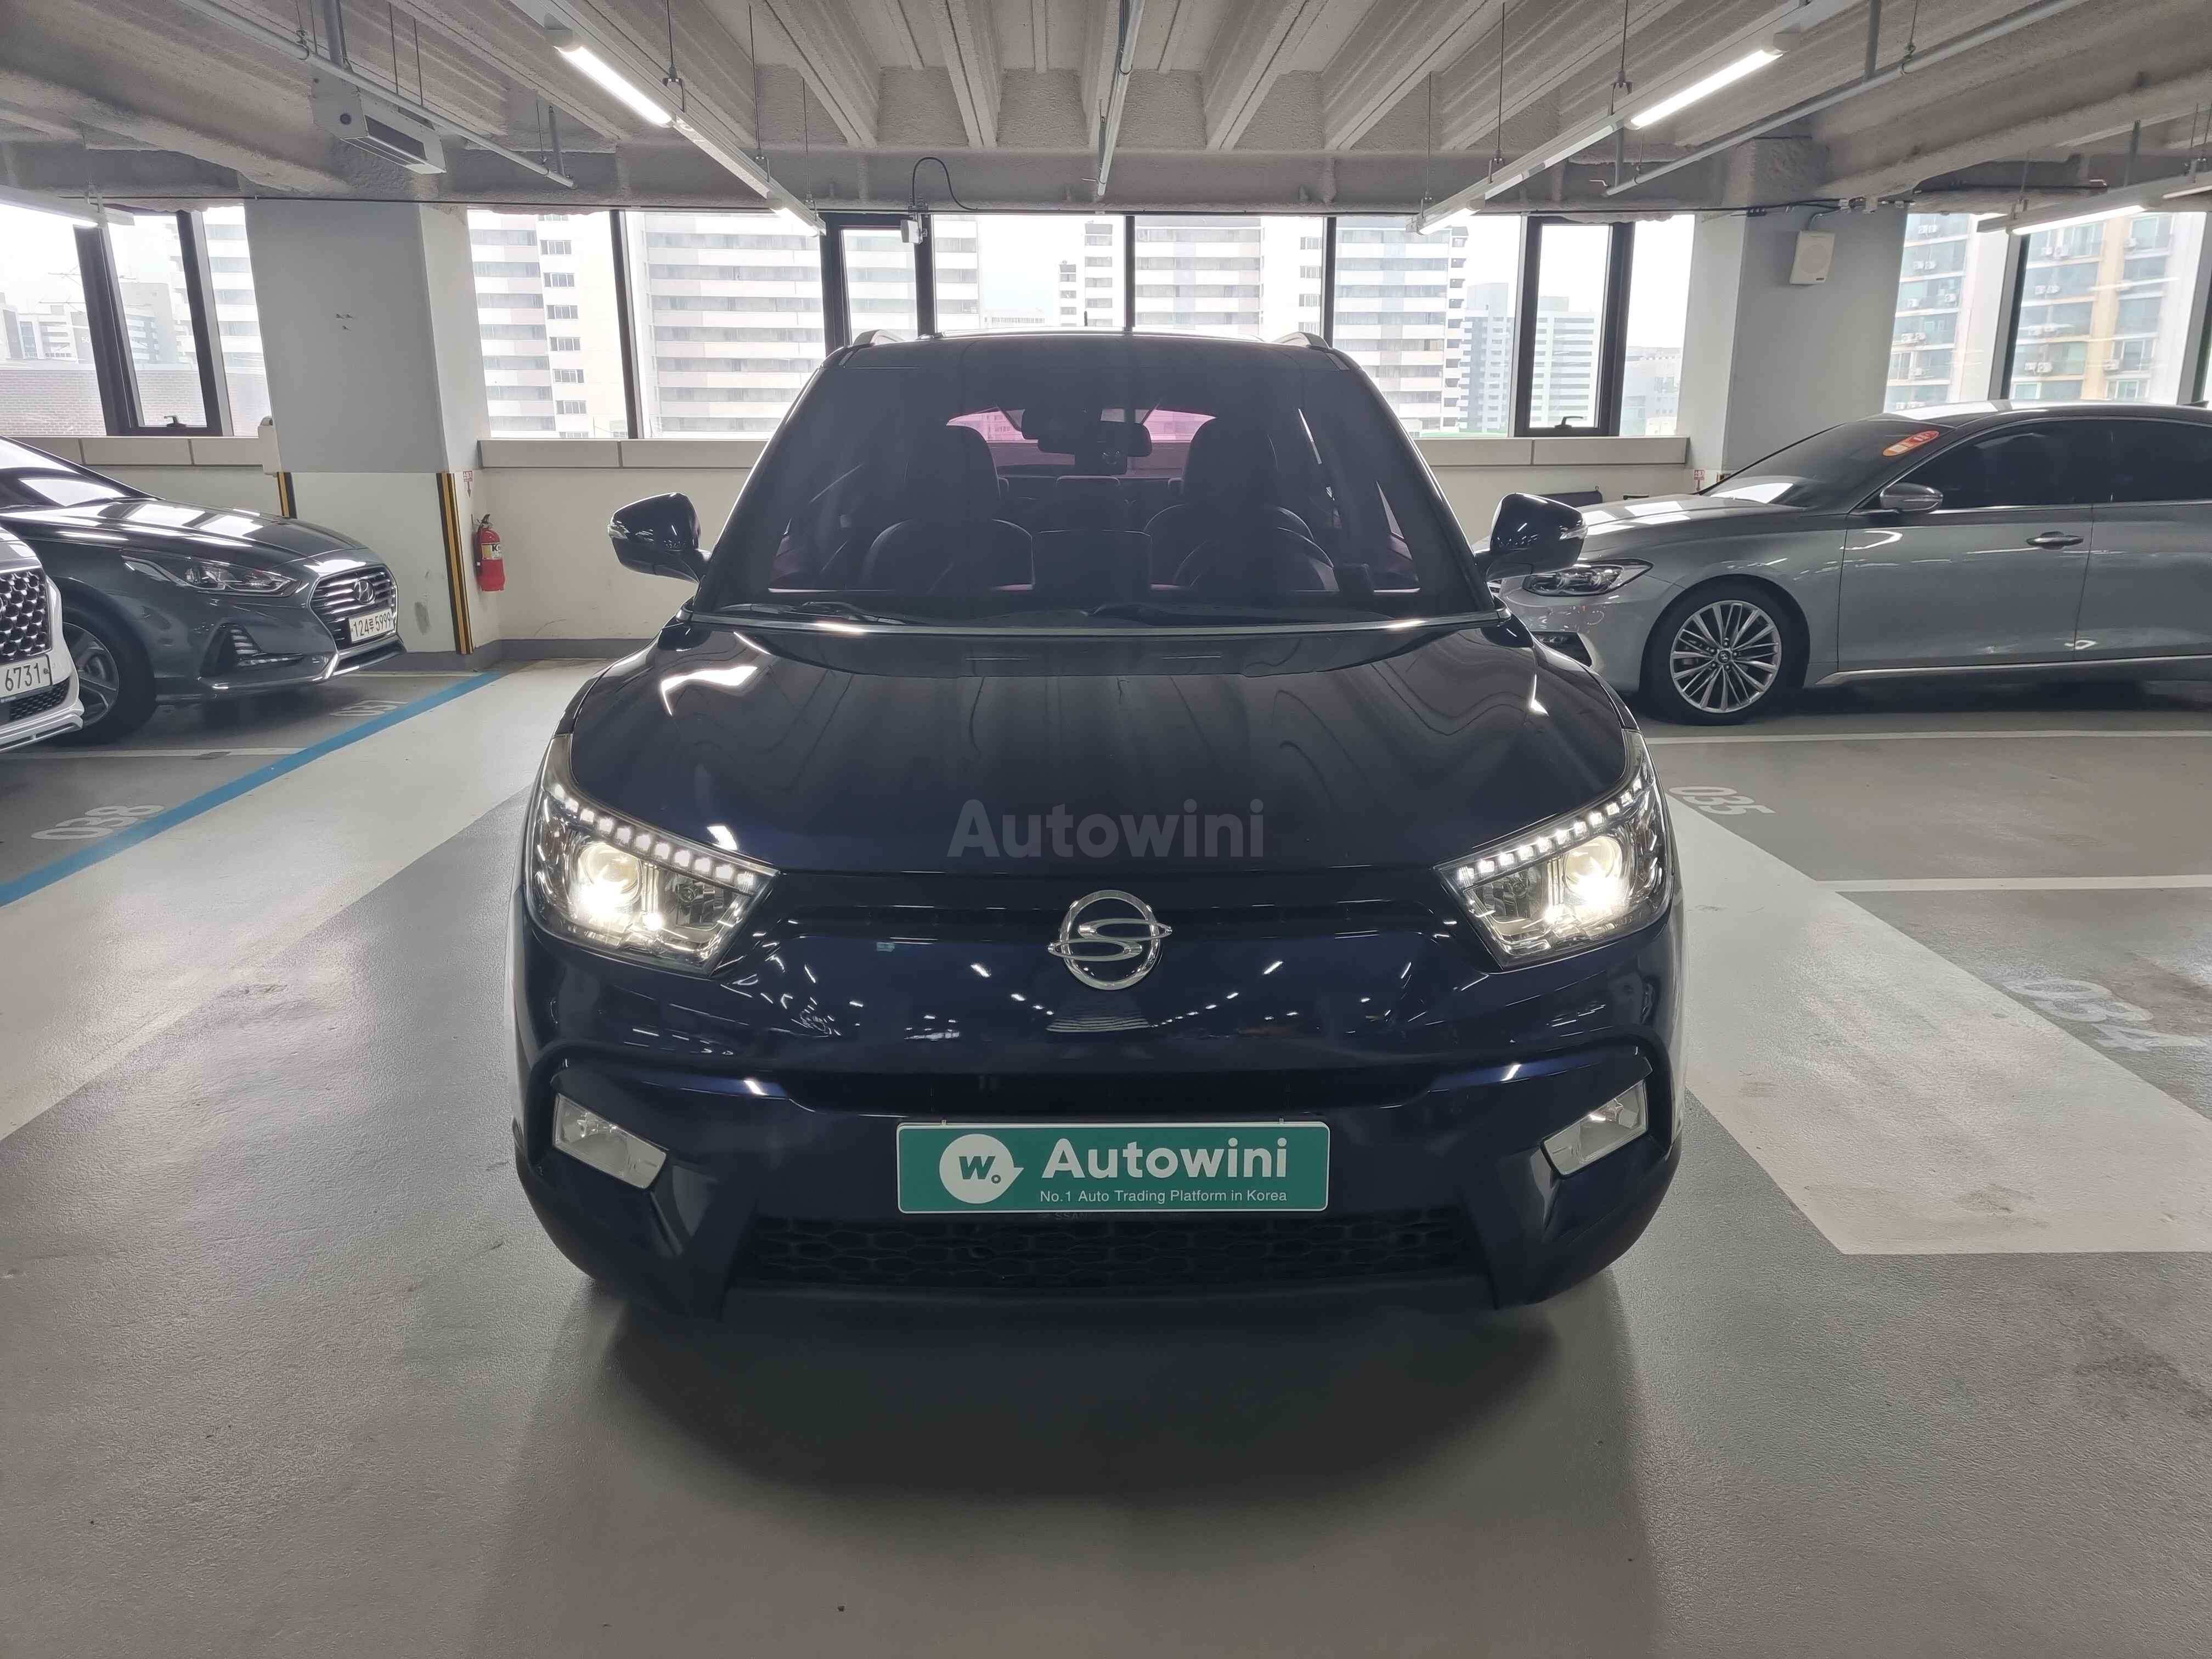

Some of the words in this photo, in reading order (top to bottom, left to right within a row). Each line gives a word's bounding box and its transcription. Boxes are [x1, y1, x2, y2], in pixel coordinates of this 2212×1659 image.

[353, 612, 391, 637] 124루5999
[5, 662, 41, 691] 6731
[1669, 786, 1776, 815] 035
[31, 805, 165, 840] 038
[1042, 1137, 1287, 1178] Autowini
[1040, 1191, 1071, 1202] No.1
[1078, 1190, 1109, 1202] Auto
[1114, 1190, 1165, 1204] Trading
[1171, 1190, 1226, 1201] Platform
[1231, 1190, 1242, 1201] in
[1247, 1189, 1287, 1201] Korea
